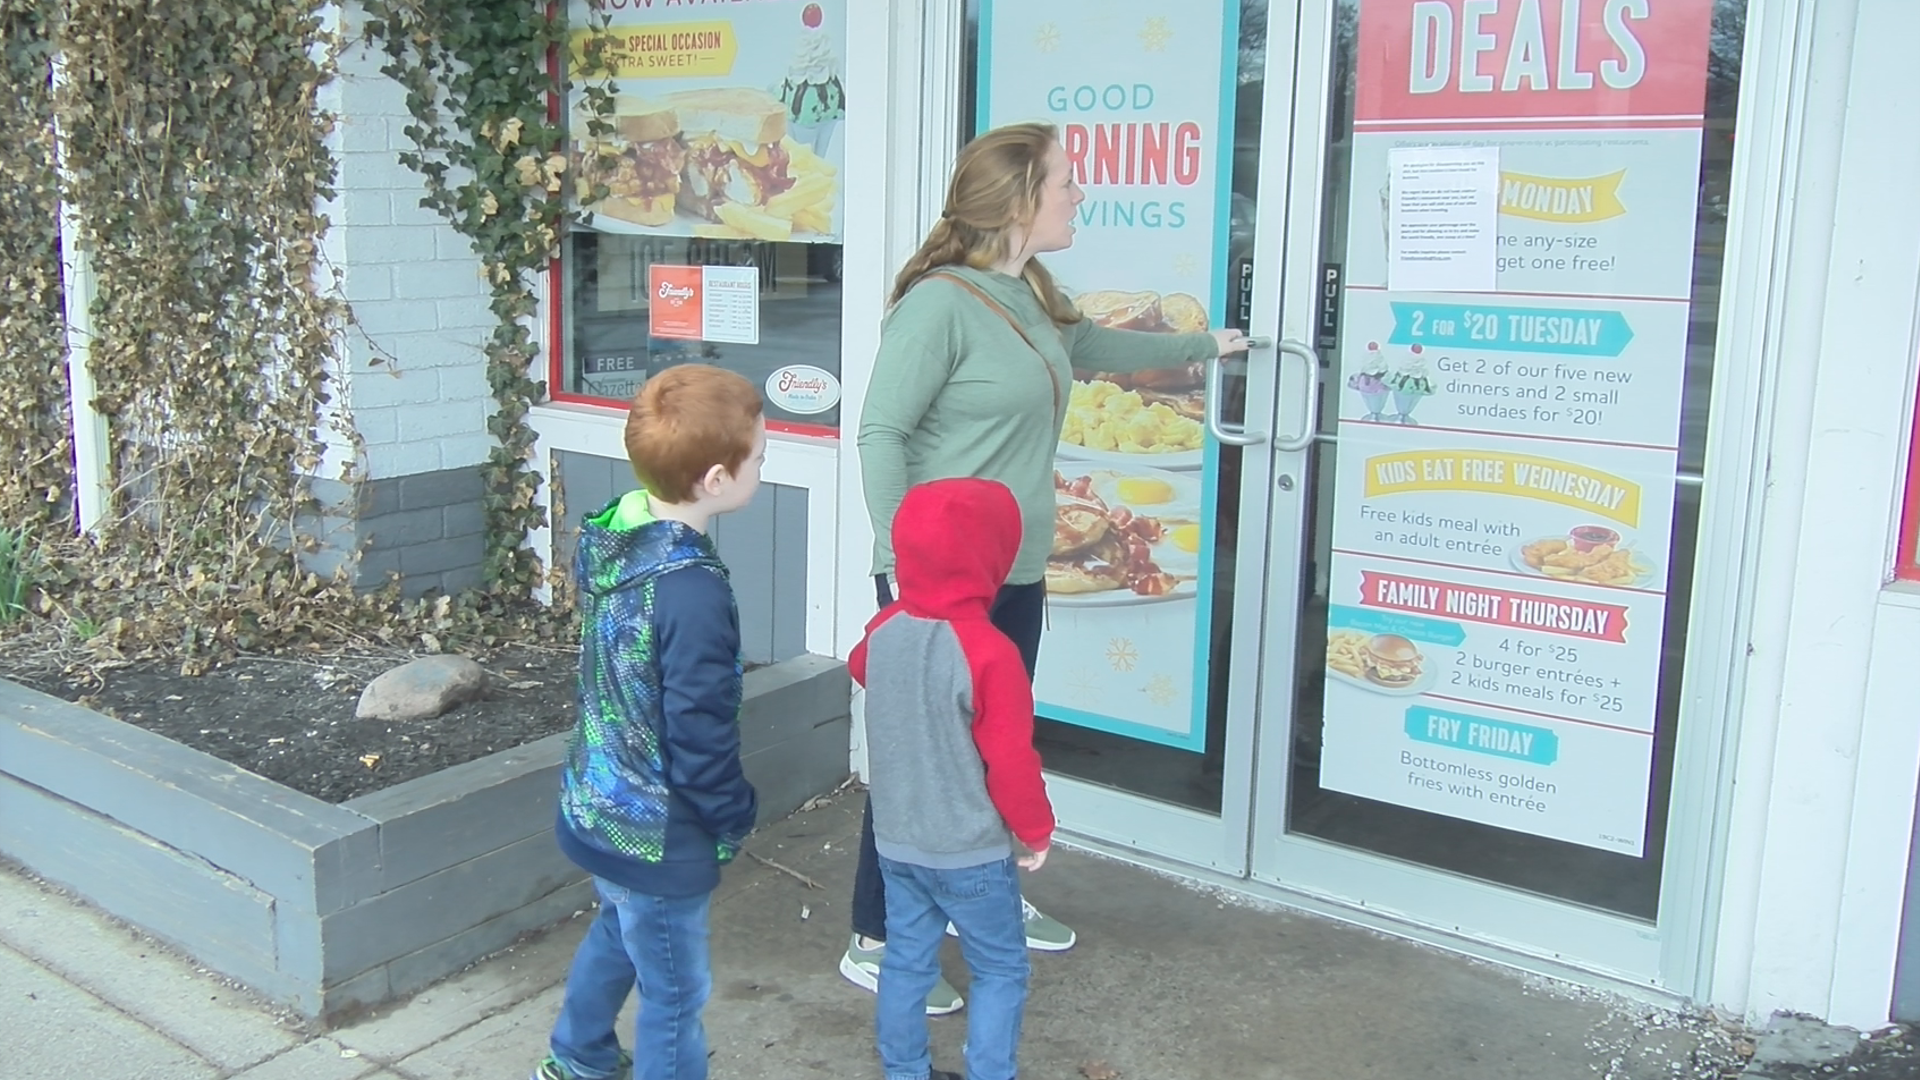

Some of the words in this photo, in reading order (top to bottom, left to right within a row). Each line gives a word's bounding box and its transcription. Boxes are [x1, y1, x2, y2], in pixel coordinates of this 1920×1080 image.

[629, 33, 667, 52] SPECIAL
[671, 31, 721, 51] OCCASION
[1409, 0, 1650, 94] DEALS
[649, 54, 697, 67] SWEET!
[1047, 84, 1154, 112] GOOD
[1065, 122, 1201, 186] RNING
[1502, 179, 1593, 215] MONDAY
[1071, 201, 1186, 228] VINGS
[1496, 235, 1517, 247] ne
[1523, 232, 1598, 251] any-size
[1496, 257, 1525, 273] get
[1532, 258, 1566, 270] one
[1572, 256, 1616, 271] free!
[1240, 264, 1252, 320] PULL
[1324, 269, 1337, 327] PULL
[1411, 310, 1424, 336] 2
[1432, 319, 1455, 336] FOR
[1463, 310, 1499, 341] $20
[1508, 315, 1602, 346] TUESDAY
[597, 357, 634, 371] FREE
[1437, 357, 1468, 373] Get
[1476, 359, 1486, 374] 2
[1492, 360, 1512, 376] of
[1517, 366, 1548, 378] our
[1554, 363, 1587, 381] five
[1593, 369, 1633, 384] new
[779, 371, 827, 393] Friendly's
[1446, 379, 1509, 398] dinners
[1516, 384, 1548, 400] and
[1554, 386, 1566, 401] 2
[1573, 389, 1619, 405] small
[1457, 403, 1527, 421] sundaes
[1533, 406, 1560, 422] for
[1566, 407, 1603, 426] $20!
[1375, 461, 1416, 486] KIDS
[1422, 458, 1455, 482] EAT
[1461, 459, 1505, 484] FREE
[1513, 462, 1626, 511] WEDNESDAY
[1360, 505, 1397, 523] Free
[1402, 510, 1433, 528] kids
[1438, 516, 1478, 533] meal
[1483, 521, 1521, 538] with
[1374, 530, 1394, 542] an
[1399, 532, 1440, 549] adult
[1445, 538, 1503, 556] entrée
[1377, 580, 1440, 611] FAMILY
[1446, 588, 1502, 620] NIGHT
[1509, 597, 1609, 635] THURSDAY
[1499, 638, 1510, 652] 4
[1516, 639, 1542, 657] for
[1549, 643, 1578, 663] $25
[1455, 651, 1467, 666] 2
[1473, 655, 1531, 677] burger
[1536, 668, 1603, 689] entrées
[1451, 671, 1462, 685] 2
[1467, 674, 1500, 692] kids
[1505, 683, 1554, 702] meals
[1560, 687, 1587, 705] for
[1593, 692, 1623, 712] $25
[1427, 715, 1461, 742] FRY
[1467, 723, 1534, 756] FRIDAY
[1400, 750, 1493, 782] Bottomless
[1498, 772, 1557, 794] golden
[1407, 771, 1443, 792] fries
[1448, 781, 1483, 800] with
[1489, 791, 1546, 813] entrée
